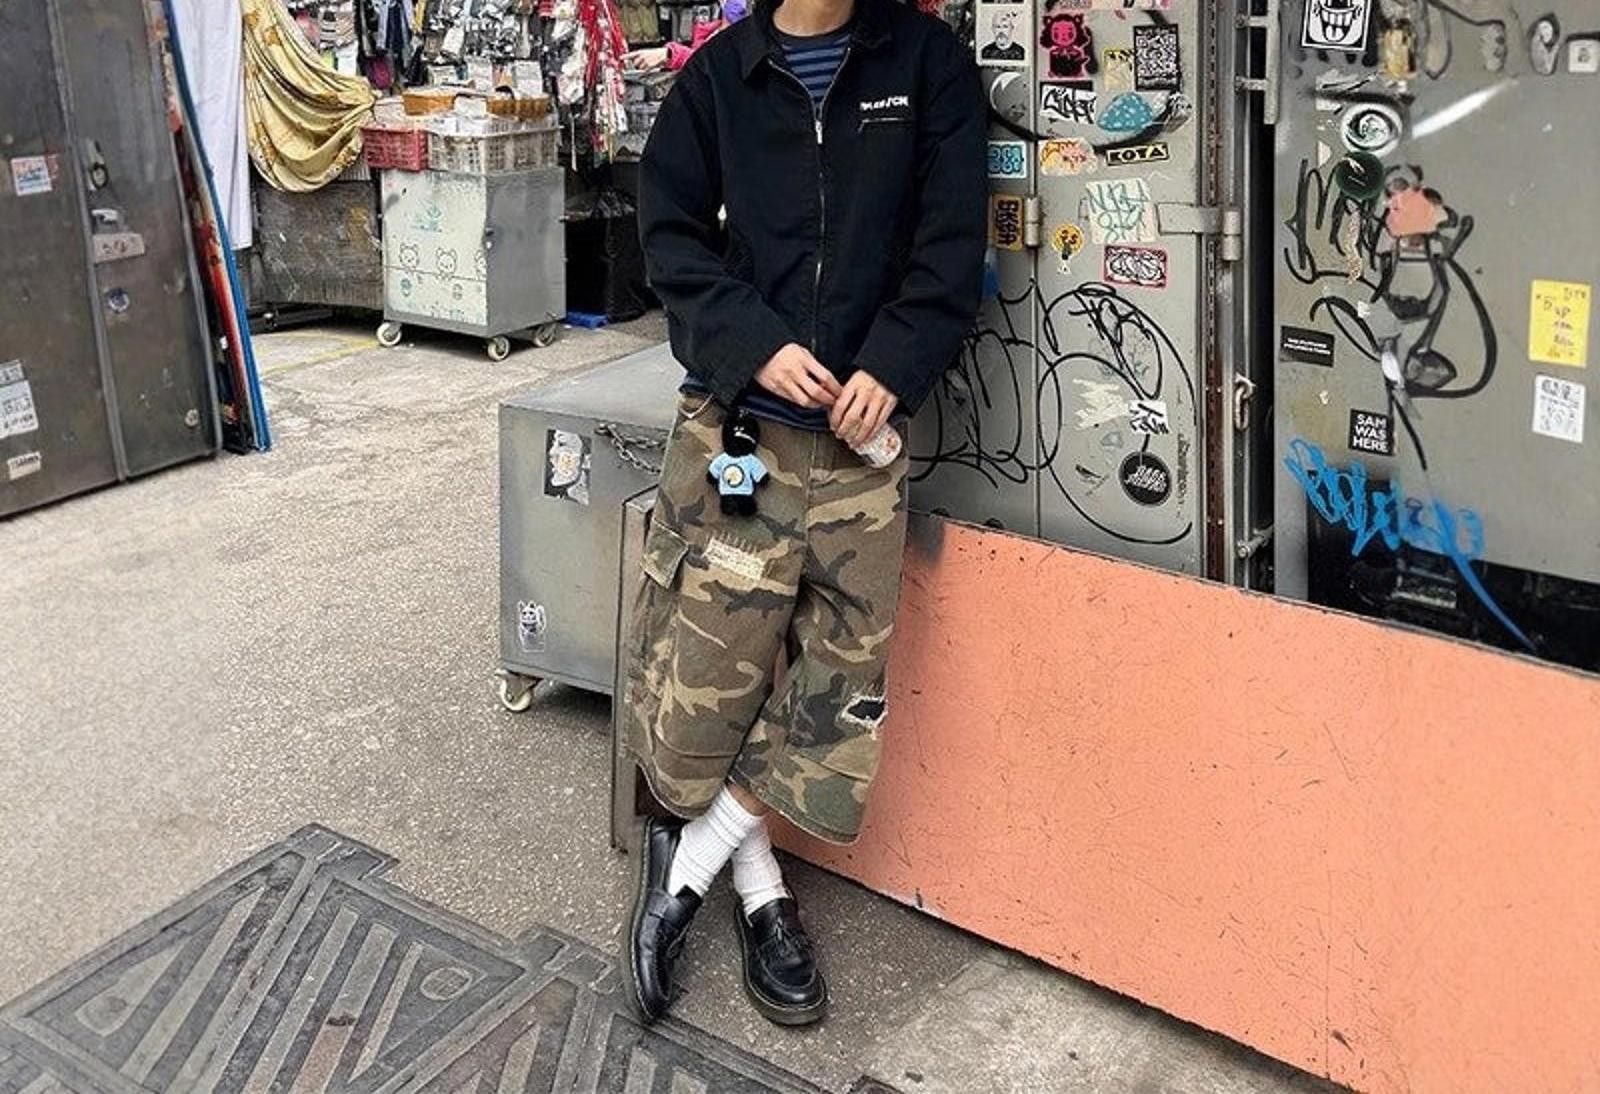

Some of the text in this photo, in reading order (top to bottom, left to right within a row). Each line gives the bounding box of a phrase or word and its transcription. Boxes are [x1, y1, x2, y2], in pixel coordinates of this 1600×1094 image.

[1356, 413, 1387, 429] SAM
[1355, 425, 1386, 441] WAS
[1353, 435, 1389, 453] HERE
